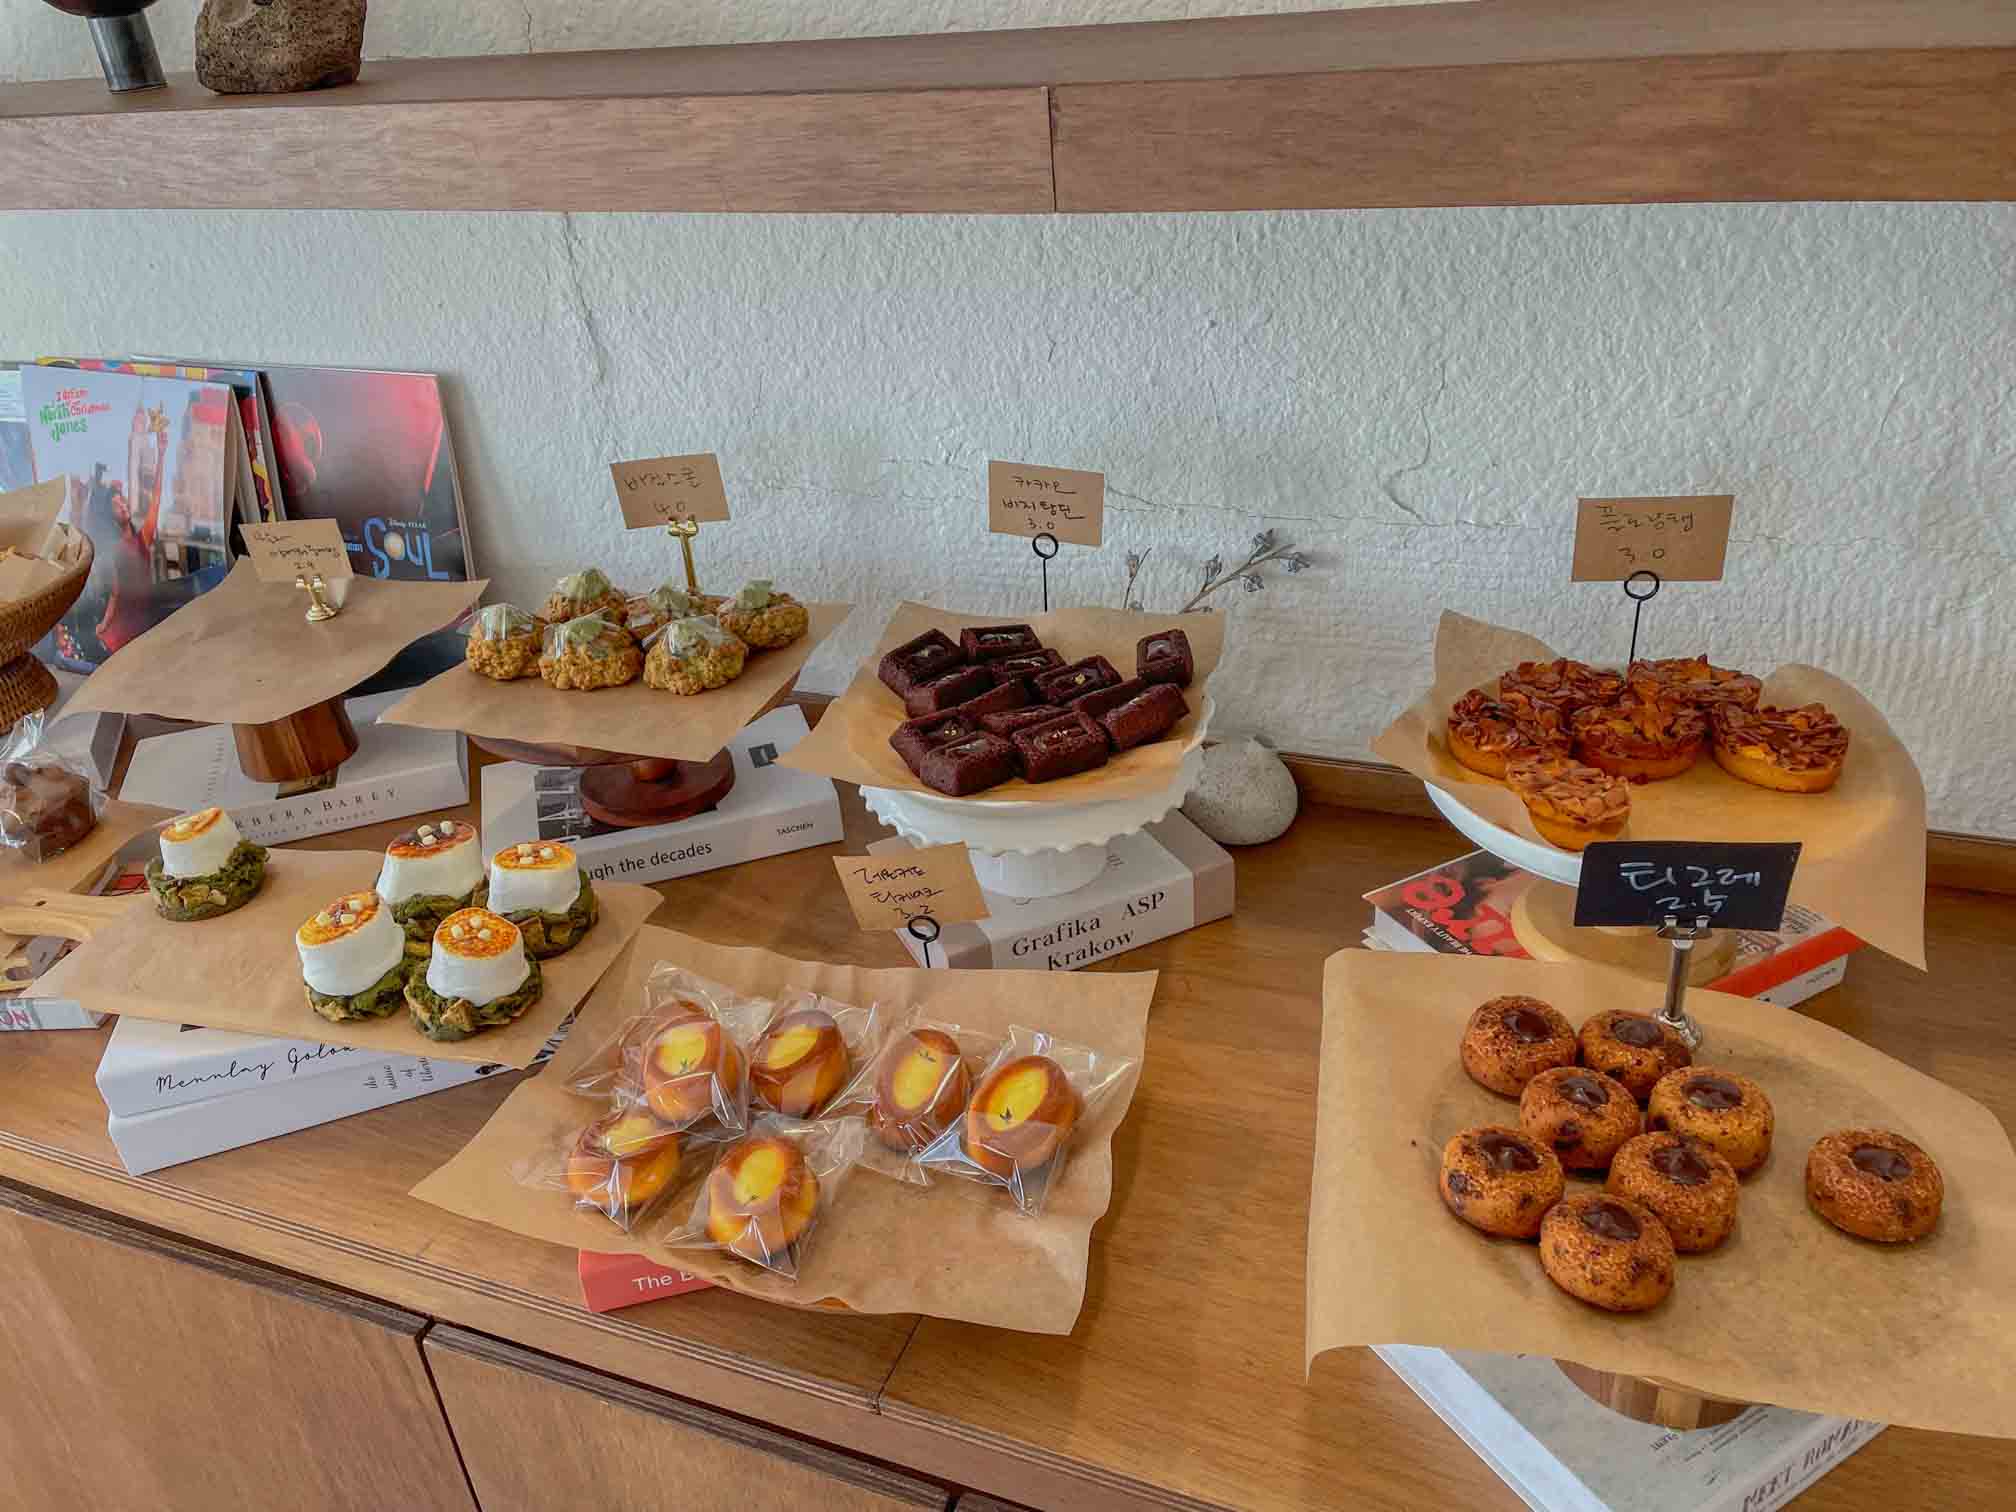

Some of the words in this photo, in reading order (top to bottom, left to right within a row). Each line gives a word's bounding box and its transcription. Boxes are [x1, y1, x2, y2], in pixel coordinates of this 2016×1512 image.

[776, 822, 815, 836] TASCHEN
[619, 854, 646, 873] the
[650, 840, 713, 868] decades
[1618, 861, 1762, 891] 티그레
[1655, 888, 1729, 913] 2.5
[1011, 915, 1102, 957] Grafika
[1121, 890, 1166, 921] ASP
[631, 1273, 673, 1292] The
